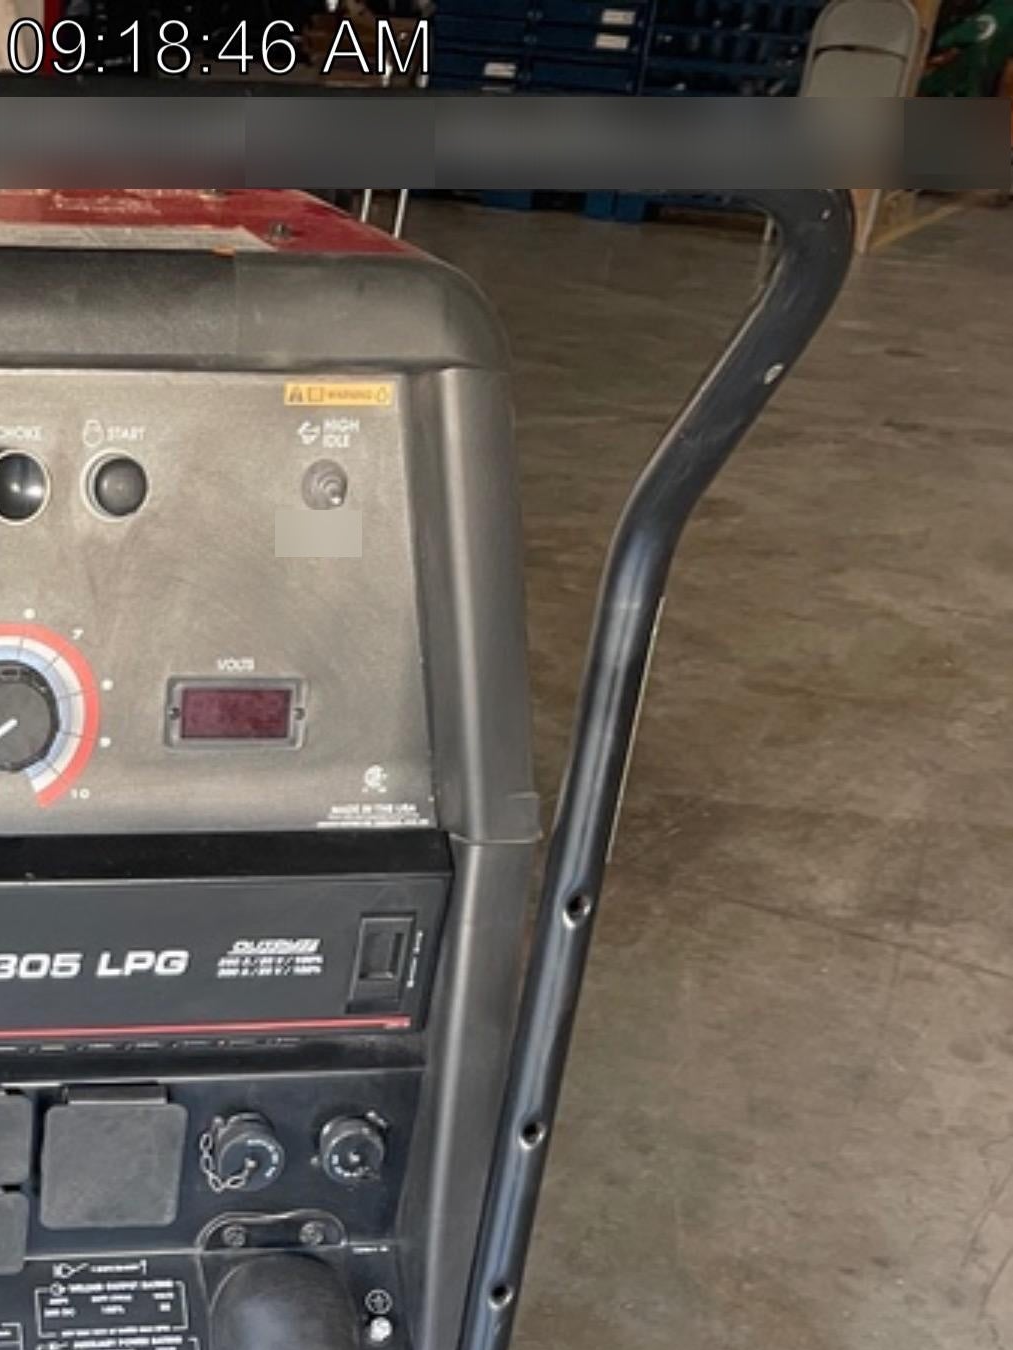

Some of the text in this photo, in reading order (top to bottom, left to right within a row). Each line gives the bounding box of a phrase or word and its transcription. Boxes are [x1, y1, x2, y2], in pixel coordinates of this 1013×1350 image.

[105, 426, 146, 440] START
[323, 418, 361, 433] HIGH
[322, 435, 351, 449] IDLE
[217, 657, 255, 672] VOLTS
[95, 950, 190, 976] LPG
